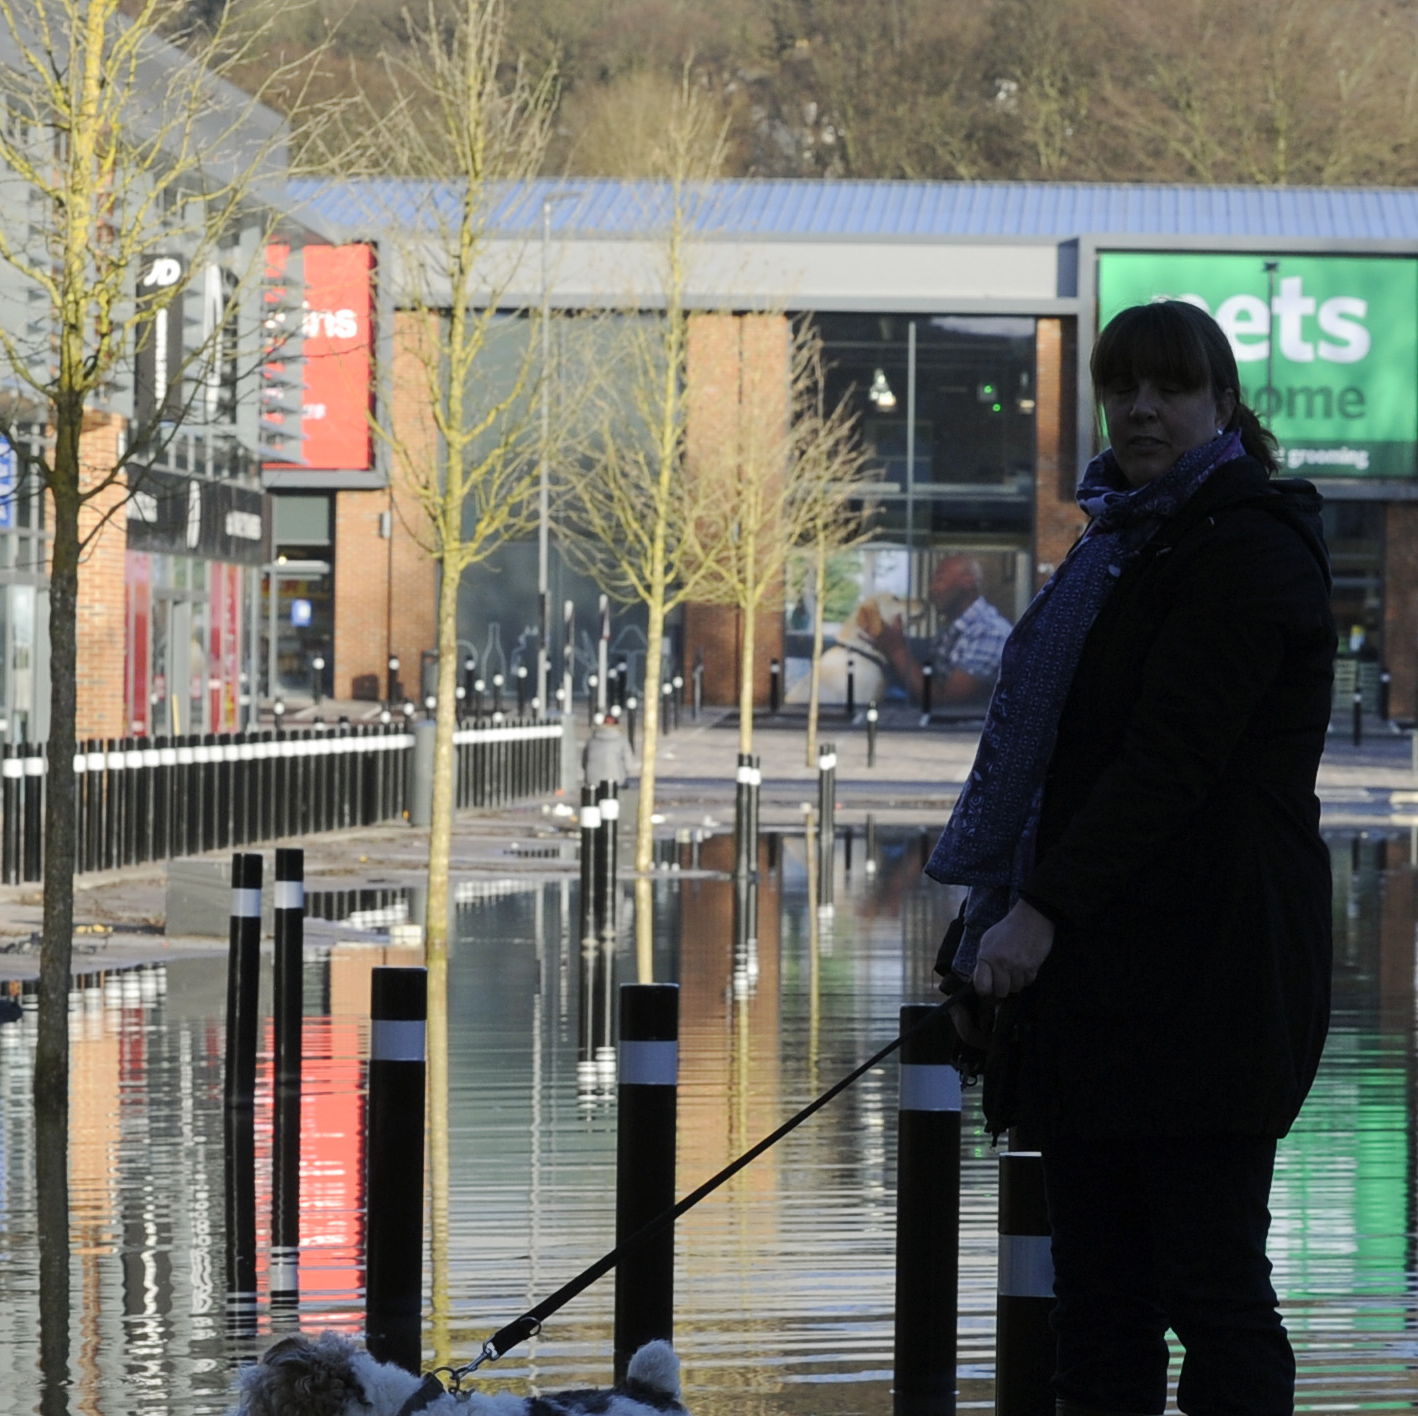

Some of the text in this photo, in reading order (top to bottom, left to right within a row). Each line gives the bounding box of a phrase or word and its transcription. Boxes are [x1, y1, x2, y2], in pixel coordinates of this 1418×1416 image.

[143, 258, 181, 287] JD
[1151, 276, 1372, 364] ets
[1287, 446, 1369, 470] grooming
